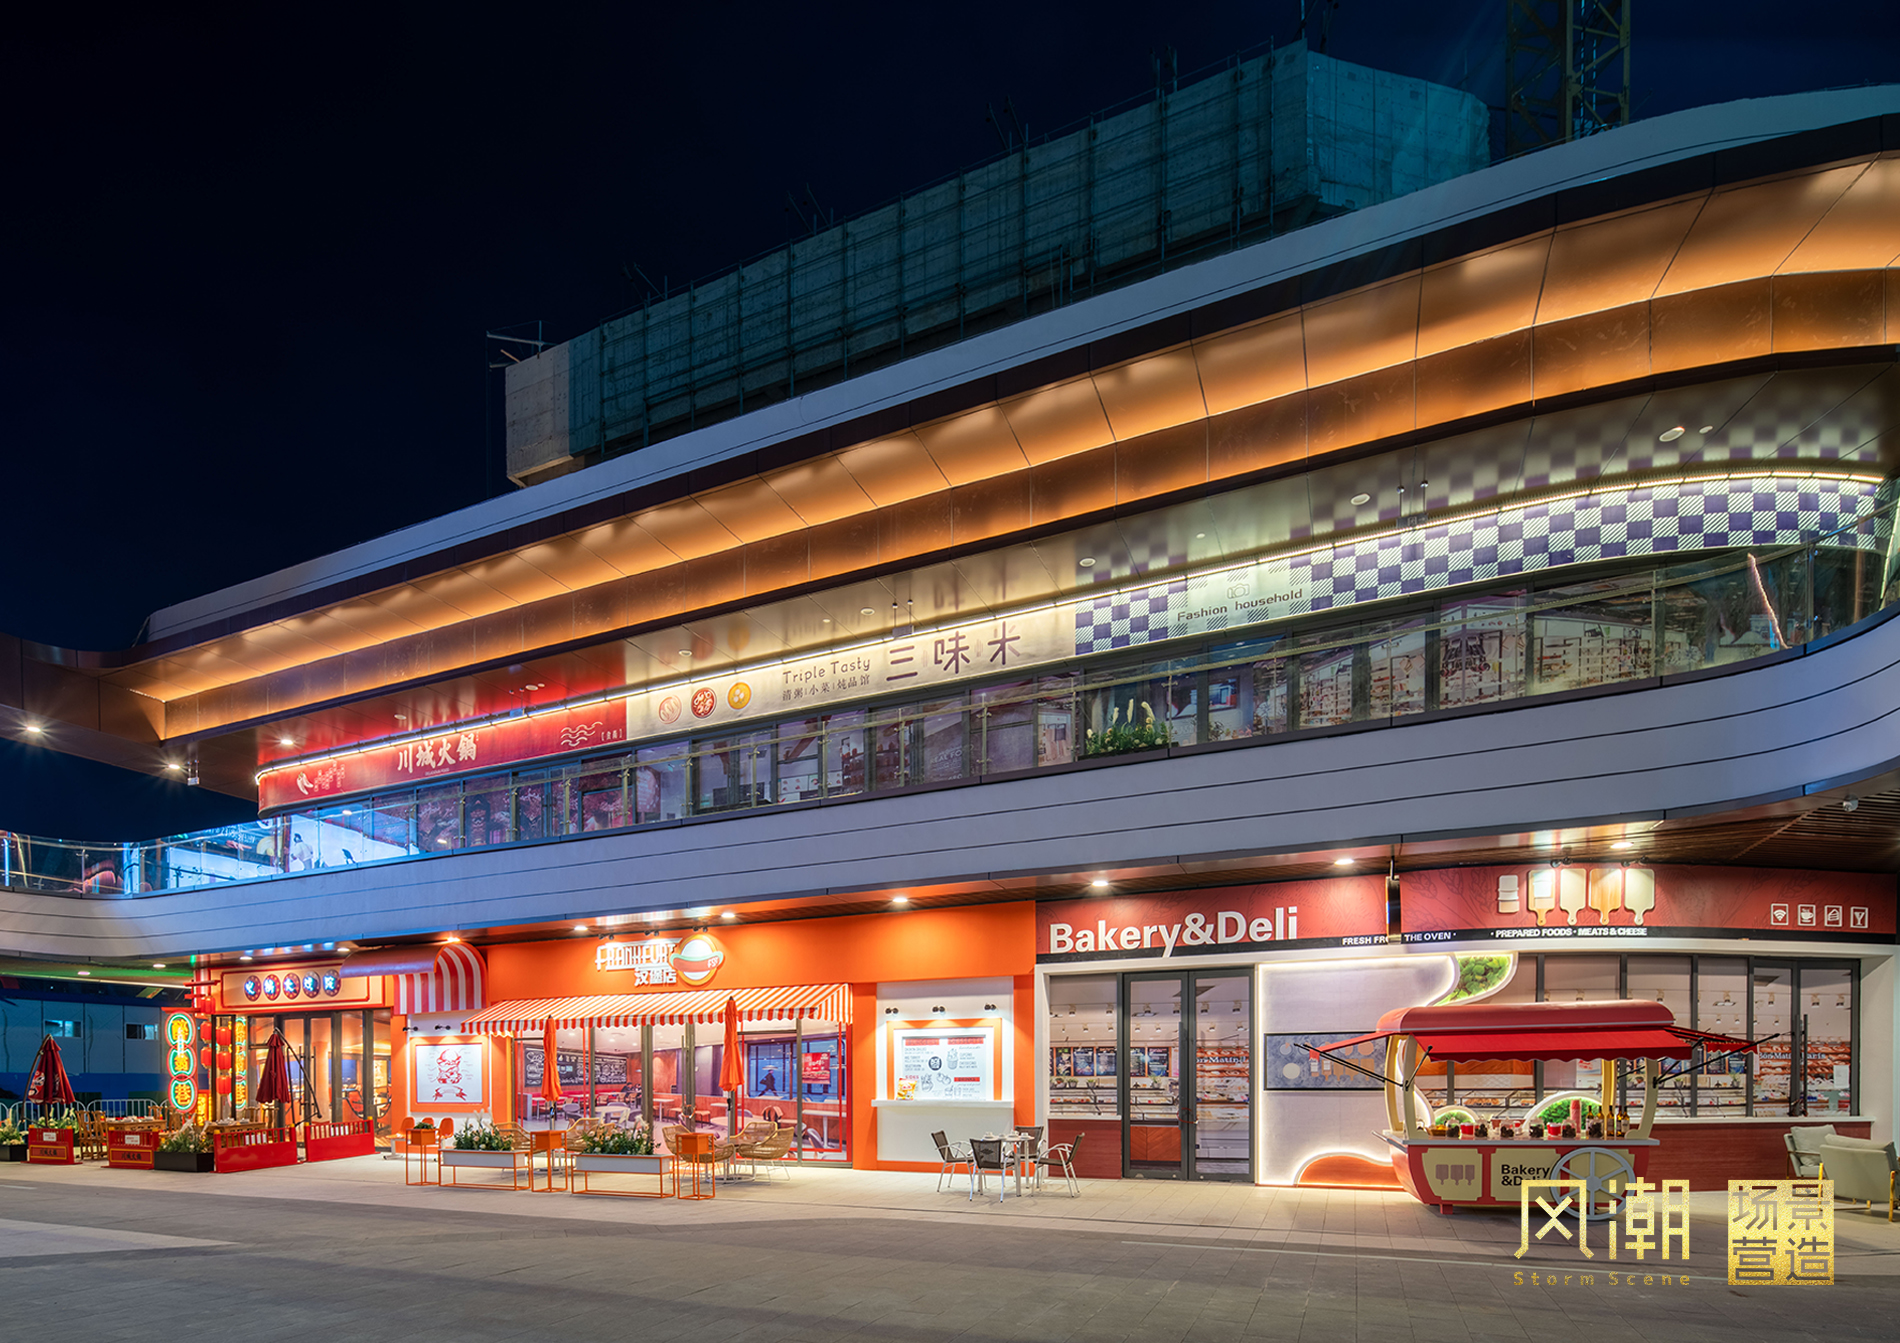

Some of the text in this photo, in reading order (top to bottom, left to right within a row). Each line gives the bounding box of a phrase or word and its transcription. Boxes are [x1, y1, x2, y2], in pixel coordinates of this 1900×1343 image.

[1177, 588, 1303, 621] Fashion household
[783, 657, 870, 684] Triple Tasty
[1049, 905, 1298, 958] Bakery&Deli
[1342, 936, 1372, 946] FRESH
[1404, 933, 1422, 942] THE
[1423, 932, 1452, 941] OVEN
[1495, 929, 1541, 938] PREPARED
[1541, 928, 1573, 937] FOODS
[1577, 927, 1608, 936] MEATS
[1609, 927, 1617, 936] &
[1617, 927, 1648, 936] CHEESE
[634, 967, 677, 987] 汉堡店
[1501, 1164, 1550, 1179] Bakery
